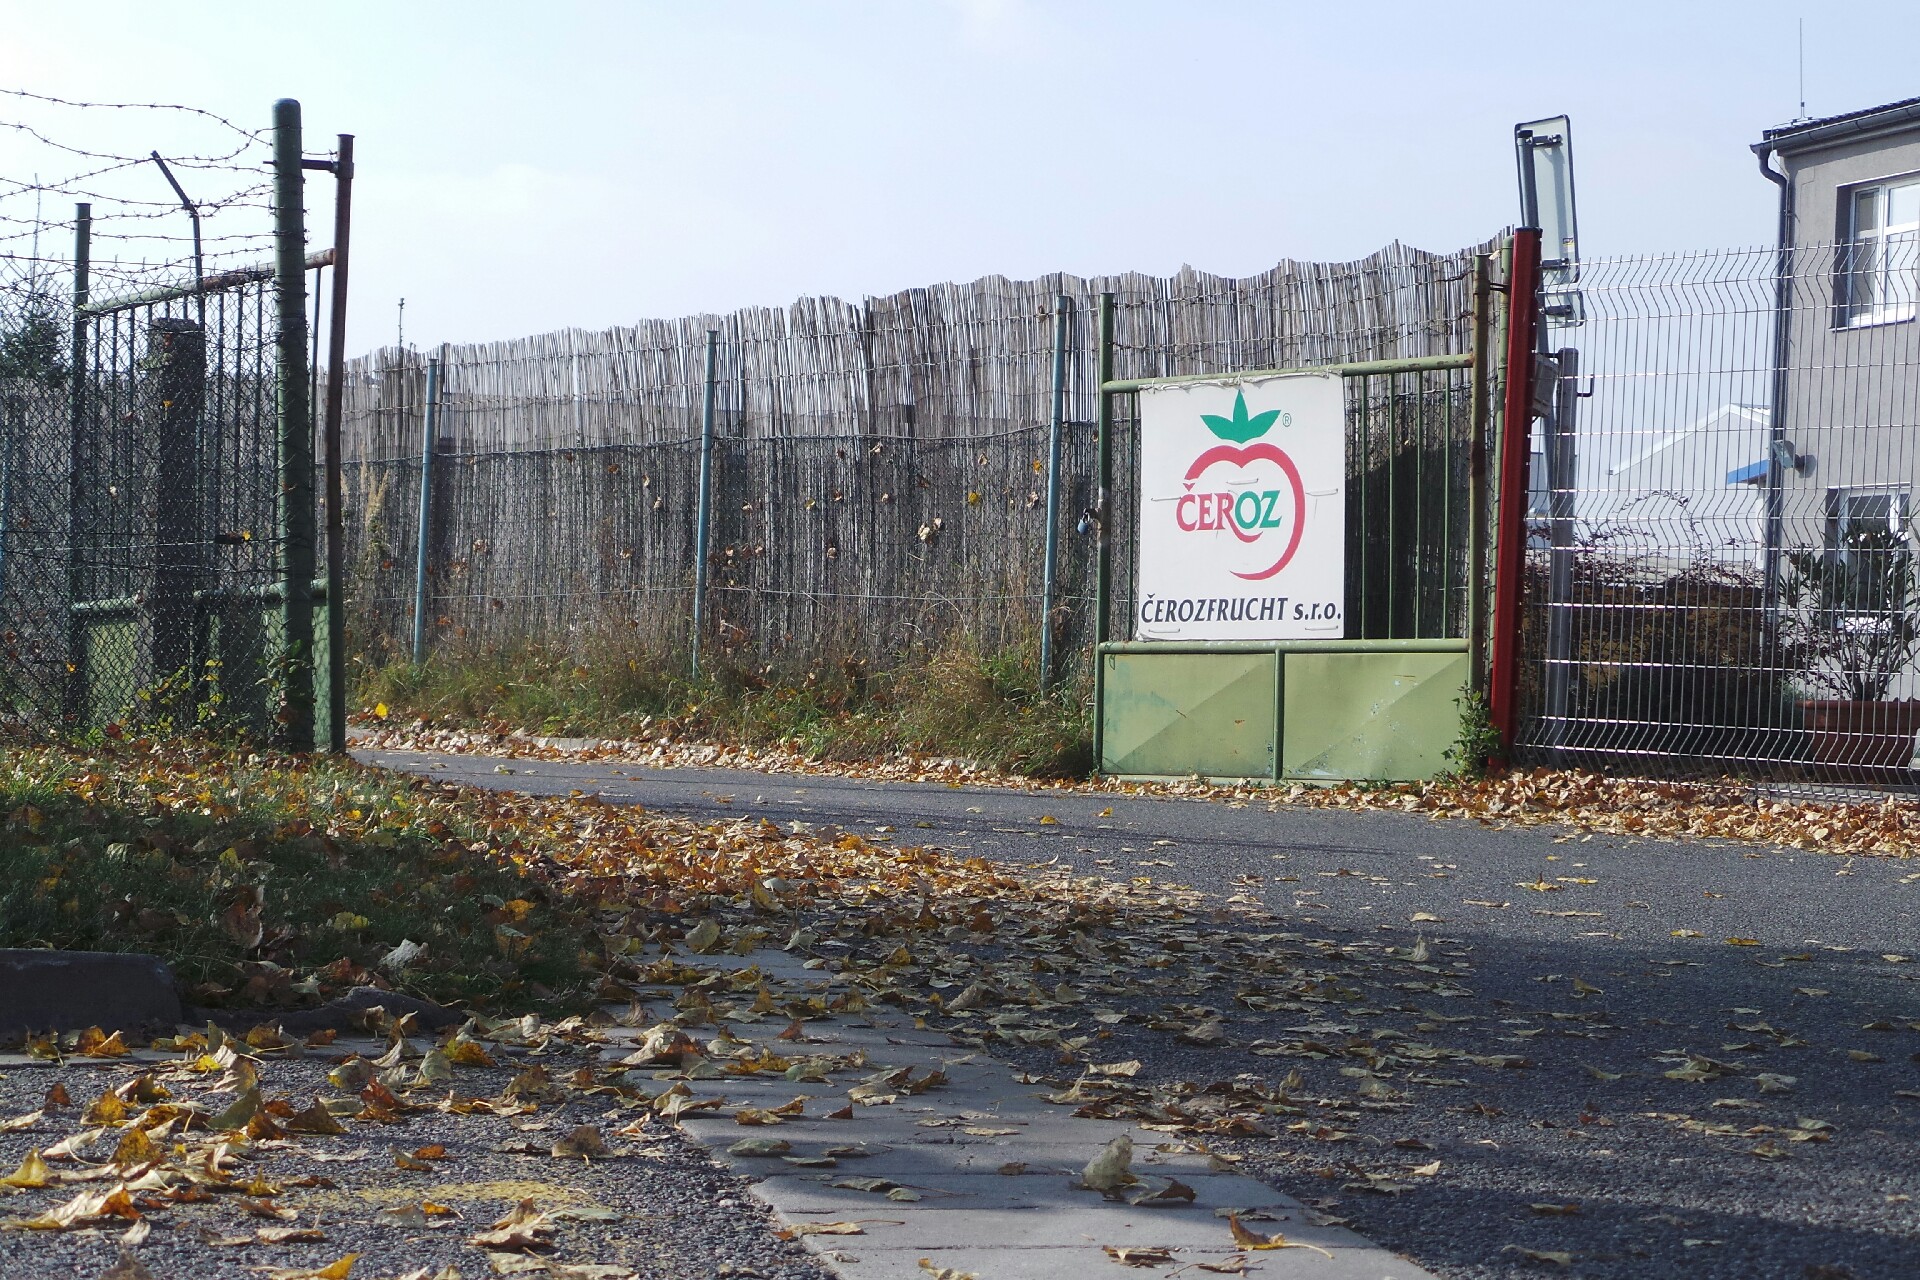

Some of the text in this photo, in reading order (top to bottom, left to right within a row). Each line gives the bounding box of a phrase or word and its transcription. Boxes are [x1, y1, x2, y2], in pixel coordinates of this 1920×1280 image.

[1176, 482, 1283, 543] ČEROZ
[1141, 593, 1342, 623] ČEROZFRUCHT s.r.o.
